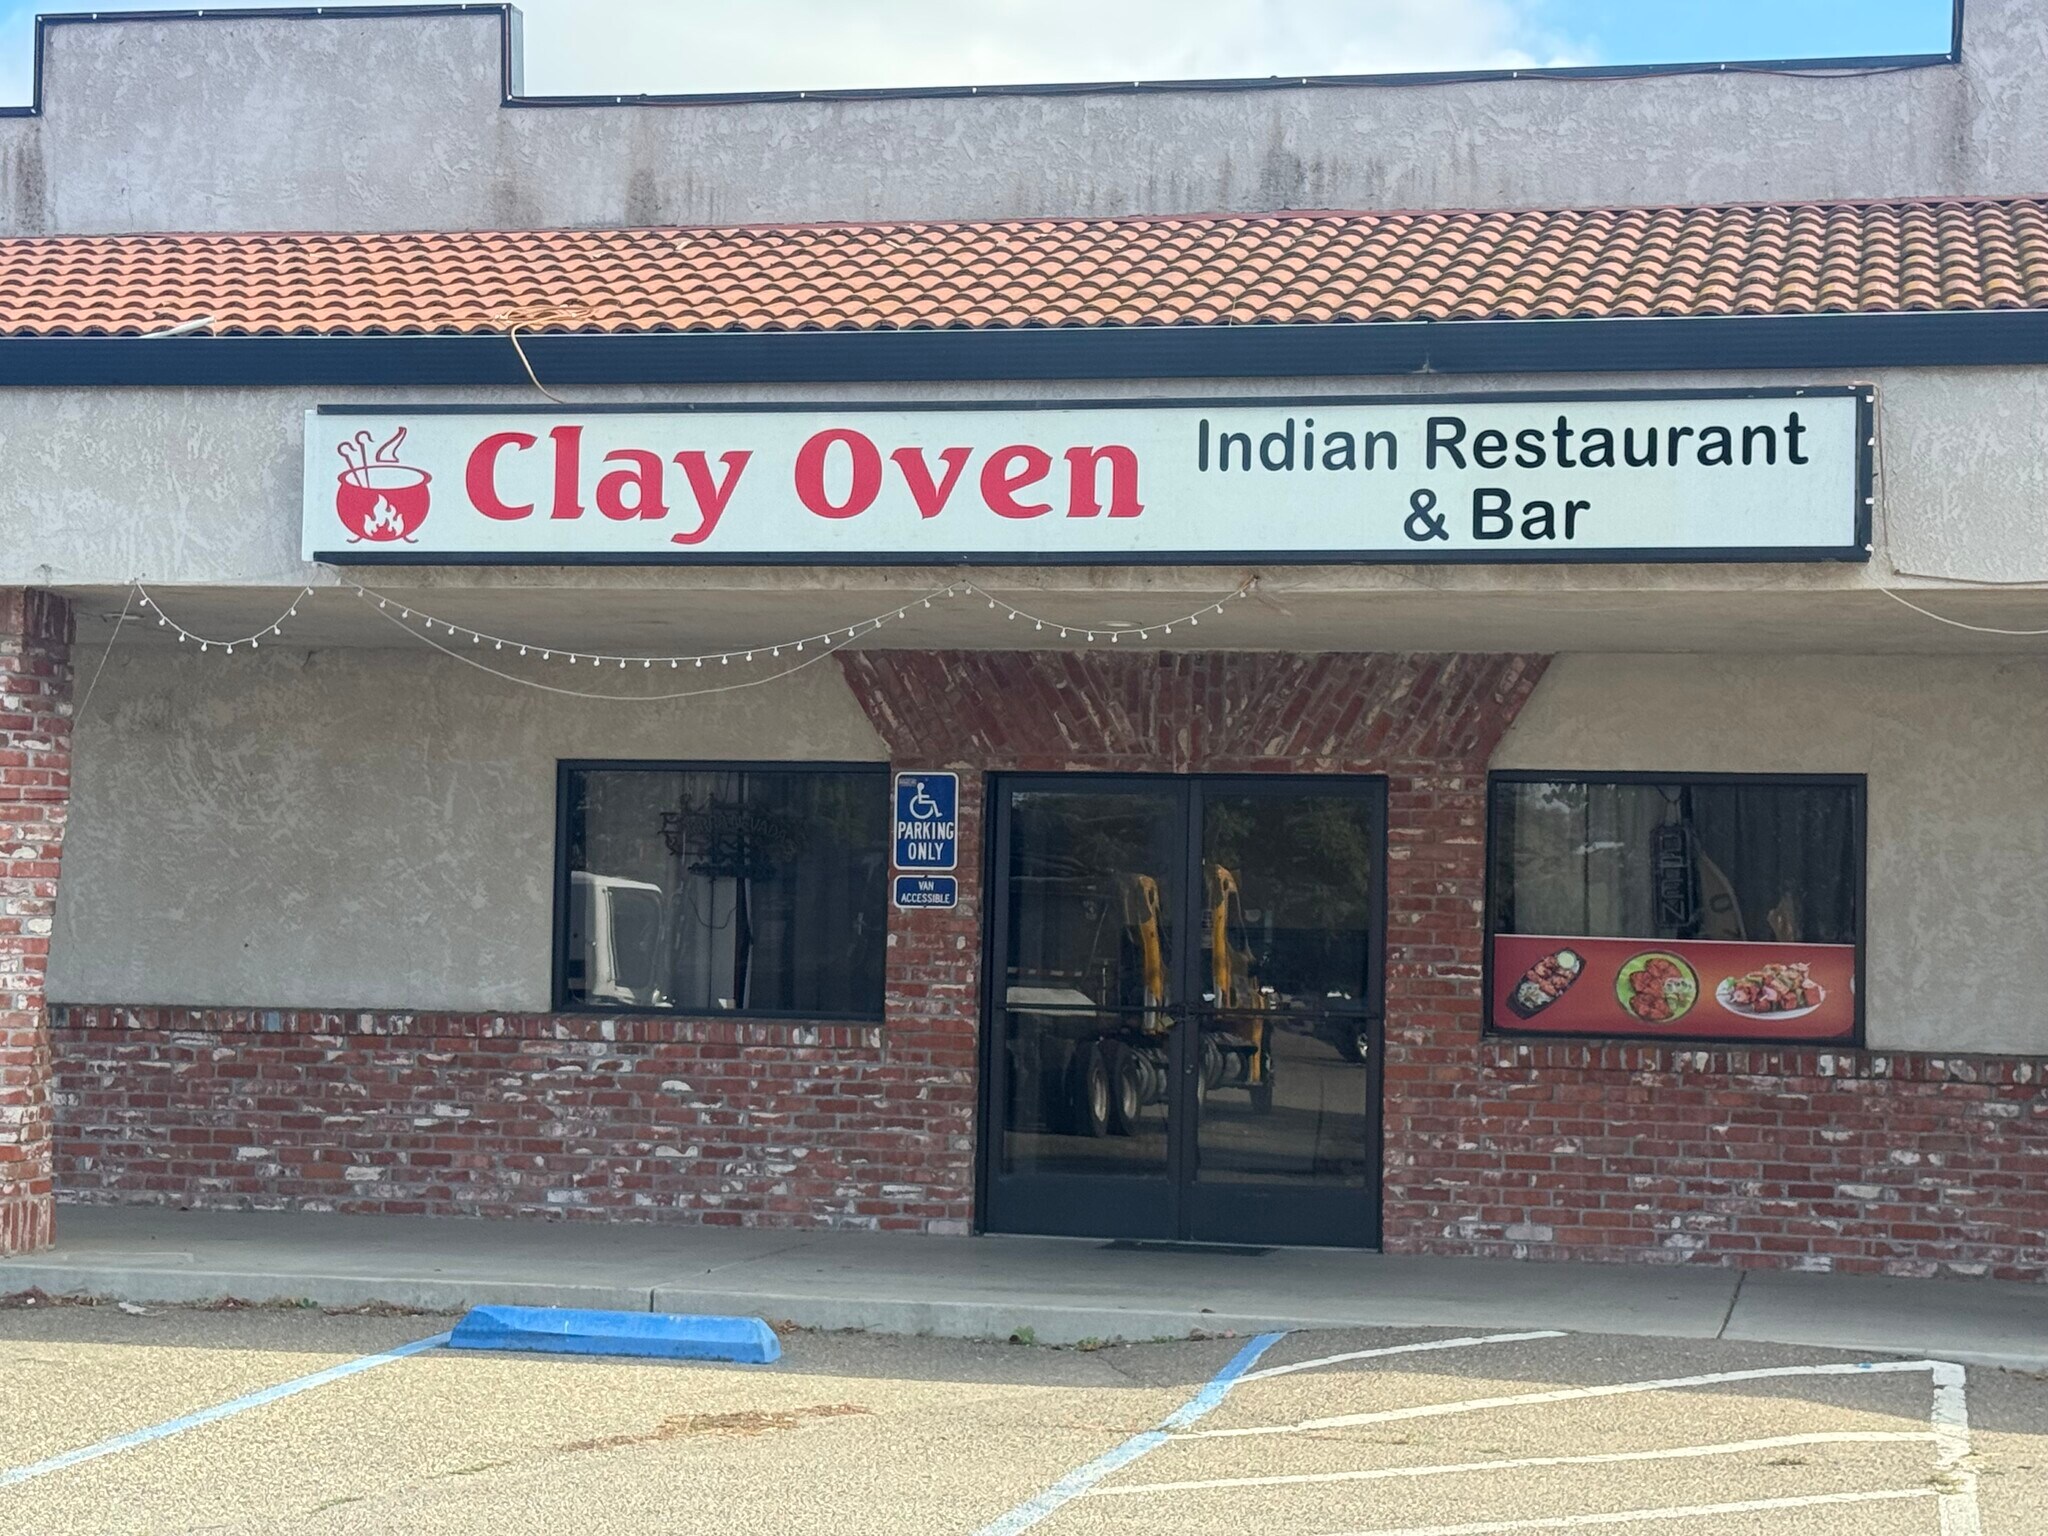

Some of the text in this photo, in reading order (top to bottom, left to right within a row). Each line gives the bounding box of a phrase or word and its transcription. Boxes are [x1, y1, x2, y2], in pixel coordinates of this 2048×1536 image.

[1199, 411, 1809, 472] Indian Restaurant
[466, 426, 1143, 544] Clay Oven
[1403, 487, 1590, 541] & Bar
[898, 821, 954, 840] PARKING
[908, 843, 944, 860] ONLY
[918, 881, 934, 891] VAN
[901, 893, 950, 904] ACCESSIBLE
